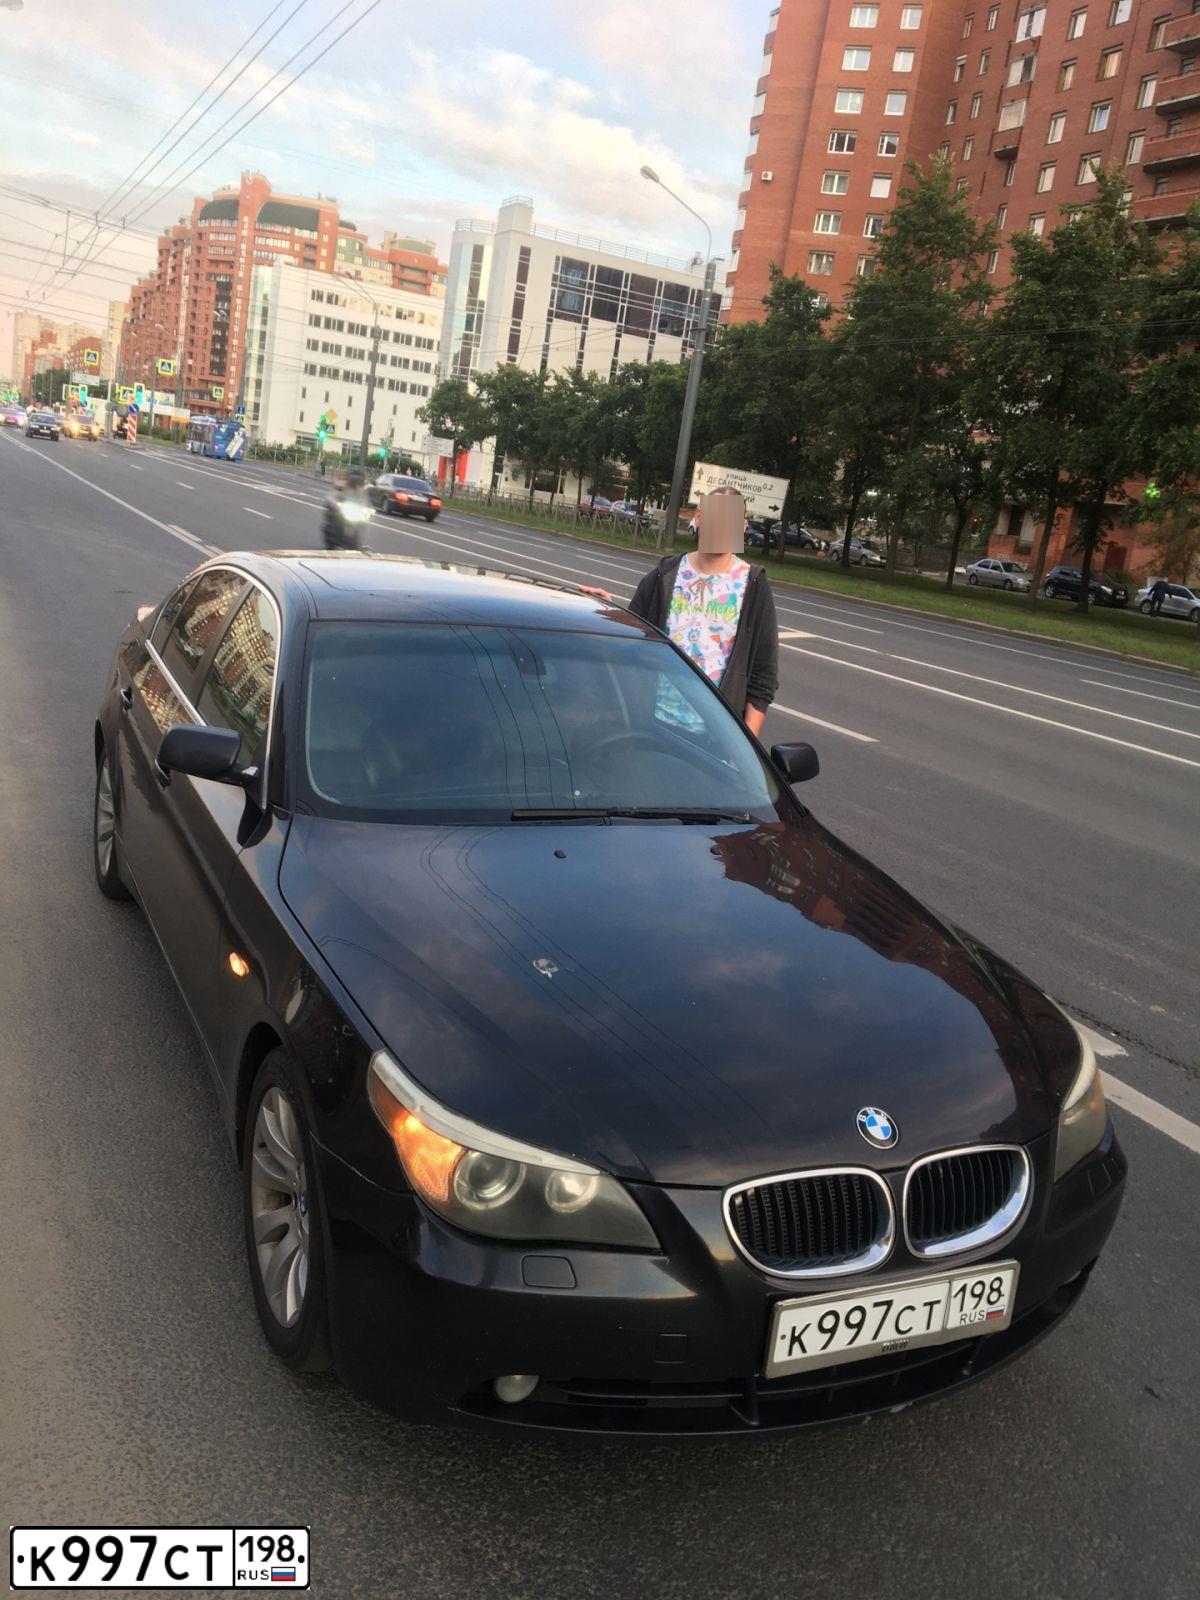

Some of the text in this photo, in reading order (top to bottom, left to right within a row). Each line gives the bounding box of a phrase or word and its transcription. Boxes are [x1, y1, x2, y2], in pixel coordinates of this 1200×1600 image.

[707, 475, 762, 492] ДЕСАНТНИКОВ
[726, 473, 747, 482] улица
[788, 1276, 1003, 1357] К997СТ 198
[960, 1310, 985, 1325] RUS
